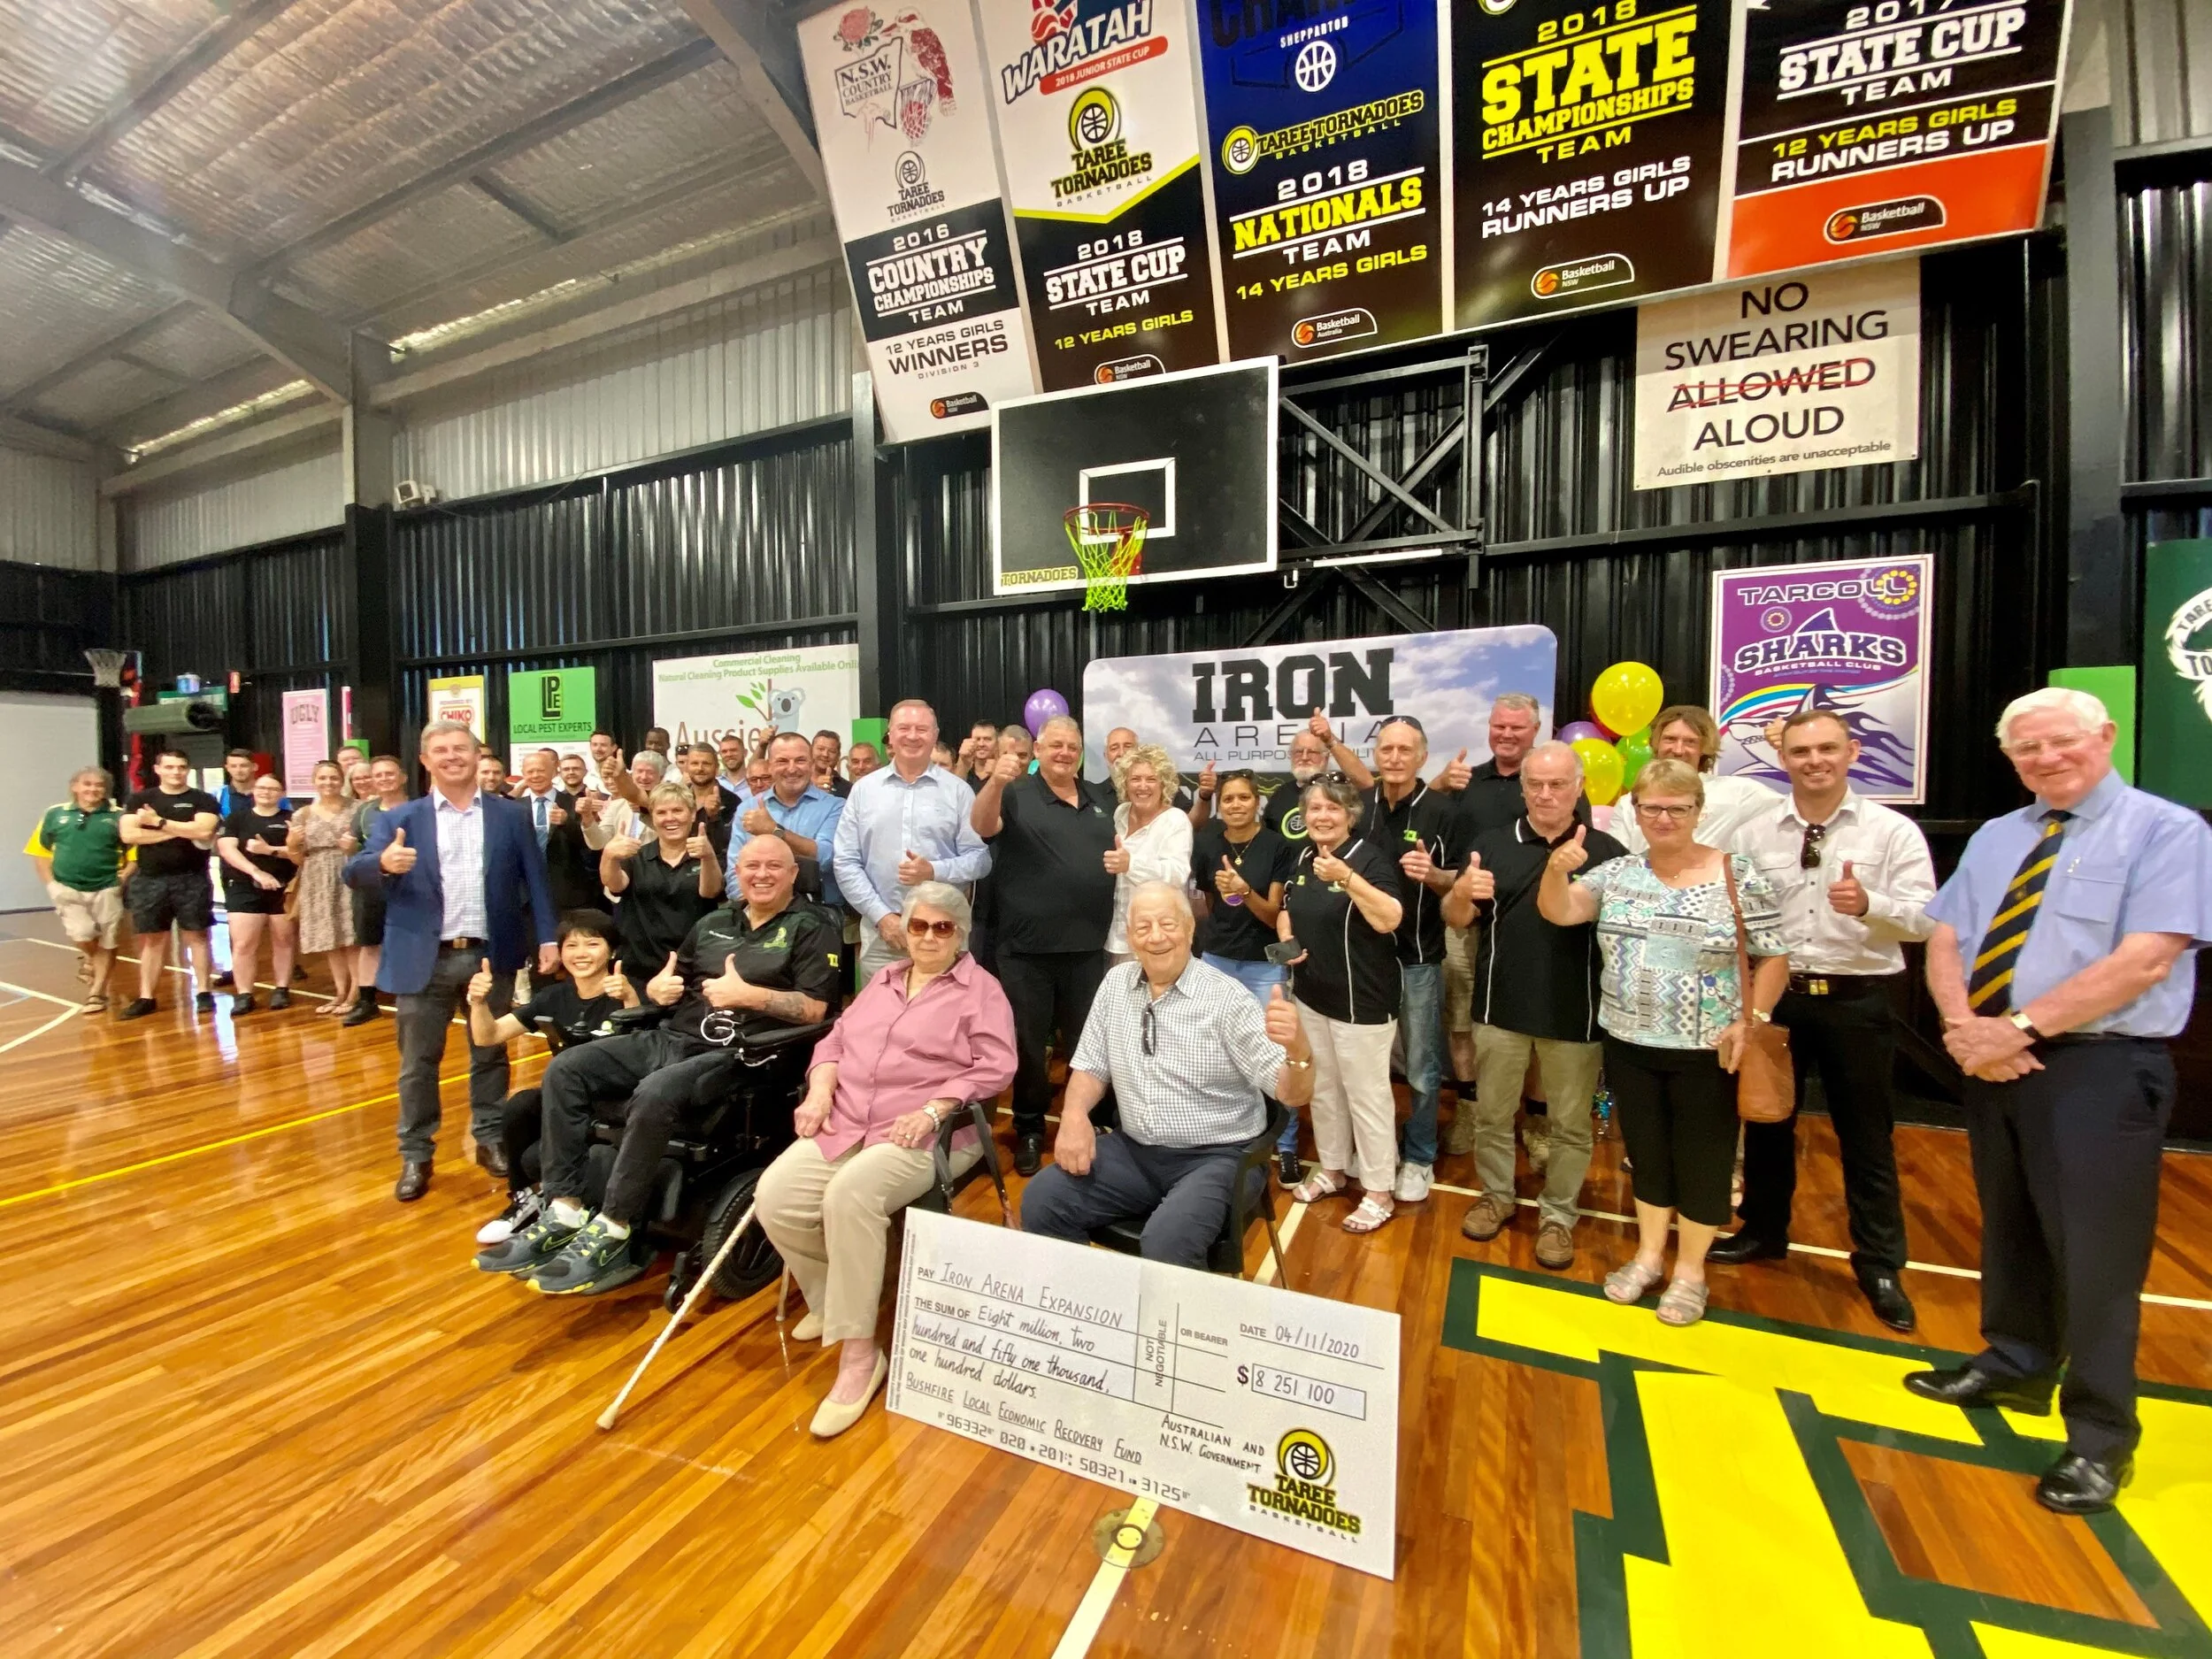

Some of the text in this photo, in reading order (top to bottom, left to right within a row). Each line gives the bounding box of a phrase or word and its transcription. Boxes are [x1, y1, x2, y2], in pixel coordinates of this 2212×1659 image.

[1537, 0, 1636, 42] 2018
[1002, 0, 1153, 104] WARATAH
[1056, 46, 1150, 88] 2018 JUNIOR STATE CUP
[1779, 7, 2026, 91] STATE CUP
[841, 54, 891, 87] N.S.W.
[842, 72, 892, 98] COUNTRY
[1482, 13, 1697, 126] STATE
[1840, 68, 1952, 106] TEAM
[845, 84, 893, 106] BASKETBALL
[1257, 91, 1422, 155] TAREE TORNADOES
[1482, 77, 1694, 151] CHAMPIONSHIPS
[1772, 98, 2017, 158] 12 YEARS GIRLS
[1071, 139, 1126, 173] TAREE
[1276, 119, 1401, 160] BASKETBALL
[1537, 127, 1632, 164] TEAM
[1770, 119, 2015, 182] RUNNERS UP
[898, 182, 930, 201] TAREE
[1050, 152, 1153, 198] TORNADOES
[1056, 176, 1153, 208] BASKETBALL
[1278, 159, 1368, 201] 2018
[1482, 156, 1691, 217] 14 YEARS GIRLS
[887, 190, 945, 217] TORNADOES
[1233, 176, 1422, 251] NATIONALS
[1482, 175, 1690, 239] RUNNERS UP
[1862, 202, 1925, 223] Basketball
[893, 224, 949, 252] 2016
[1078, 229, 1143, 260] 2018
[1283, 229, 1371, 265] TEAM
[868, 237, 987, 294] COUNTRY
[1046, 244, 1186, 303] STATE CUP
[1236, 244, 1427, 300] 14 YEARS GIRLS
[1562, 260, 1615, 280] Basketball
[873, 266, 995, 311] CHAMPIONSHIPS
[1086, 289, 1150, 316] TEAM
[1741, 281, 1809, 319] NO
[909, 300, 964, 324] TEAM
[1055, 310, 1194, 350] 12 YEARS GIRLS
[1316, 314, 1360, 332] Basketball
[886, 319, 1004, 355] 12 YEARS GIRLS
[1317, 326, 1343, 338] Australia
[1664, 310, 1888, 371] SWEARING
[888, 334, 1009, 375] WINNERS
[918, 364, 967, 380] DIVISION
[1114, 359, 1151, 374] Basketball
[946, 395, 978, 408] Basketball
[1666, 357, 1877, 413] ALLOWED
[1693, 406, 1844, 451] ALOUD
[1656, 441, 1891, 477] Audible obscenities are unacceptable
[1002, 567, 1077, 586] TORNADOES
[1737, 578, 1908, 606] TARCOLL
[713, 653, 801, 668] Commercial Cleaning
[1734, 631, 1907, 673] SHARKS
[1755, 661, 1842, 676] BASKETBALL
[1846, 661, 1881, 671] CLUB
[658, 659, 858, 682] Natural Cleaning Product Supplies Available Onli
[1192, 648, 1394, 724] IRON
[513, 722, 592, 734] LOCAL PEST EXPERTS
[1194, 720, 1382, 748] AREA
[1194, 751, 1222, 761] ALL
[918, 1267, 934, 1279] PAY
[915, 1297, 971, 1319] THE SUM OF
[911, 1314, 957, 1348] hundred
[962, 1335, 987, 1355] and
[991, 1339, 1016, 1365] fifty
[1021, 1357, 1041, 1371] one
[978, 1305, 1015, 1328] Eight
[1071, 1325, 1095, 1352] two
[1180, 1327, 1229, 1347] OR BEARER
[1240, 1323, 1267, 1338] DATE
[1275, 1325, 1359, 1358] 04/11/2020
[909, 1348, 927, 1363] one
[933, 1348, 986, 1382] hundred
[1146, 1340, 1155, 1362] NOT
[1155, 1319, 1168, 1387] NEGOTIABLE
[1237, 1364, 1249, 1386] $
[1255, 1370, 1335, 1405] 8 251 100
[1274, 1473, 1337, 1508] TAREE
[1247, 1483, 1361, 1535] TORNADOES
[1249, 1505, 1357, 1544] BASKETBALL
